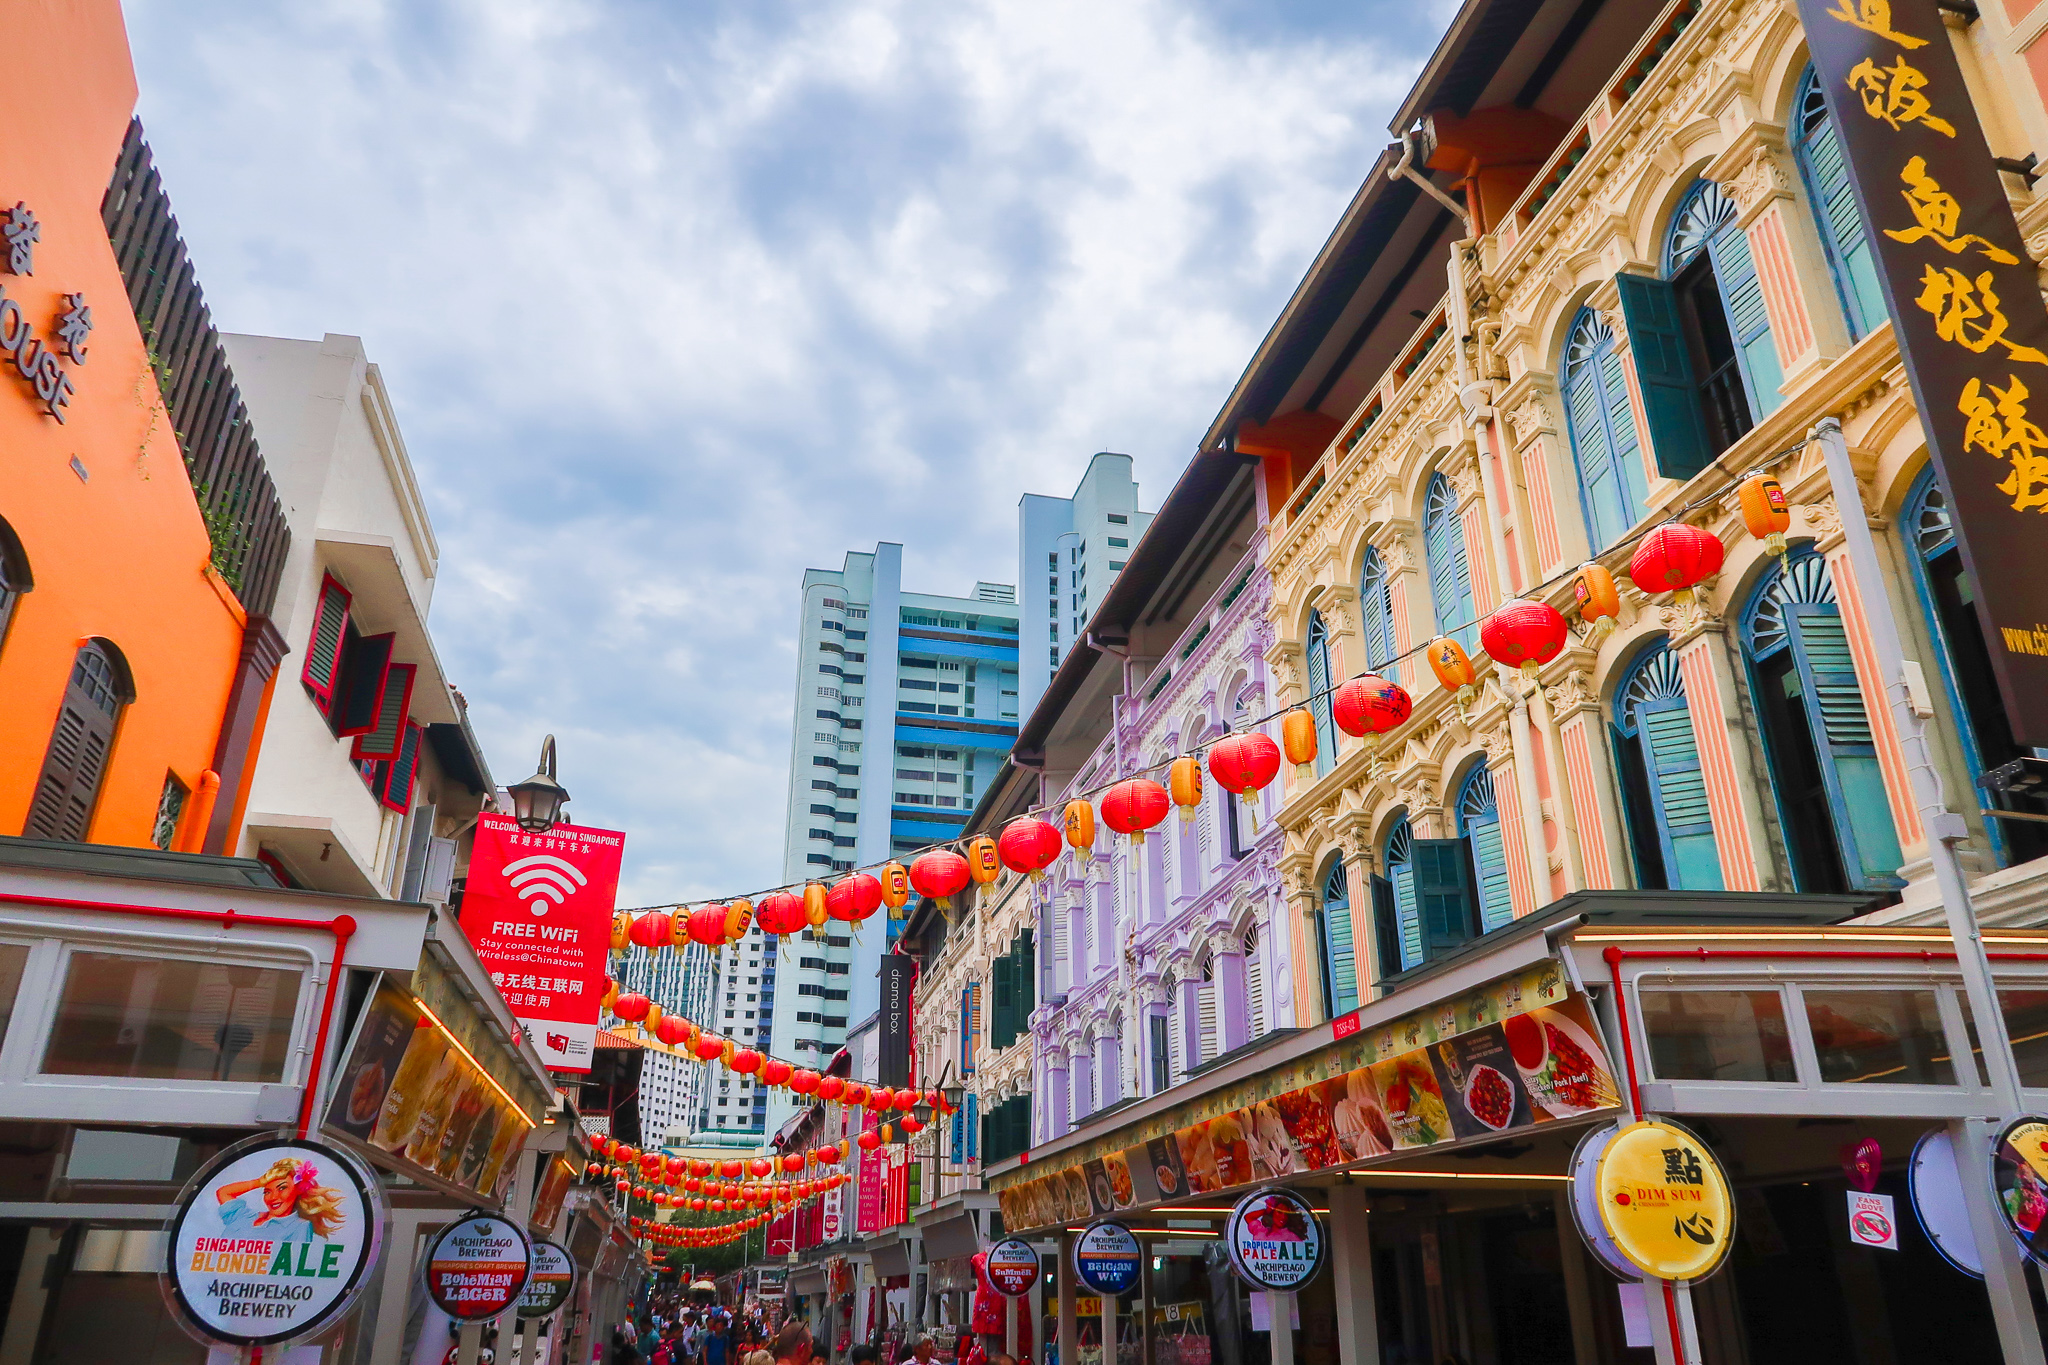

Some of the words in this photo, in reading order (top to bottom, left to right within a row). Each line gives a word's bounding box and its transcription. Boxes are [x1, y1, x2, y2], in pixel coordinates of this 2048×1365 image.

[0, 284, 75, 425] OUSE
[484, 820, 520, 833] WELCOME
[579, 833, 620, 847] SINGAPORE
[509, 834, 591, 854] 欢迎来到牛车水
[492, 921, 537, 938] FREE
[541, 925, 578, 943] WiFi
[480, 938, 502, 949] Stay
[505, 941, 560, 955] connected
[562, 947, 584, 957] with
[476, 949, 584, 968] Wireless@Chinatown
[890, 969, 902, 1009] drama
[890, 1013, 901, 1034] box
[1637, 1188, 1666, 1200] DIM
[1671, 1189, 1702, 1201] SUM
[1857, 1197, 1881, 1206] FANS
[1855, 1204, 1885, 1213] ABOVE
[863, 1220, 874, 1228] 16
[195, 1237, 273, 1254] SINGAPORE
[451, 1236, 513, 1248] ARCHIPELAGO
[1090, 1236, 1129, 1244] ARCHIPELAGO
[1242, 1241, 1276, 1250] TROPICAL
[458, 1247, 503, 1258] BREWERY
[1242, 1249, 1277, 1260] PALE
[1278, 1241, 1316, 1260] ALE
[190, 1252, 271, 1275] BLONDE
[269, 1242, 344, 1278] ALE
[534, 1256, 561, 1264] IPELAGO
[1254, 1261, 1305, 1272] ARCHIPELAGO
[1004, 1276, 1023, 1285] IPA
[1262, 1271, 1300, 1282] BREWERY
[207, 1279, 313, 1301] ARCHIPELAGO
[218, 1298, 297, 1319] BREWERY
